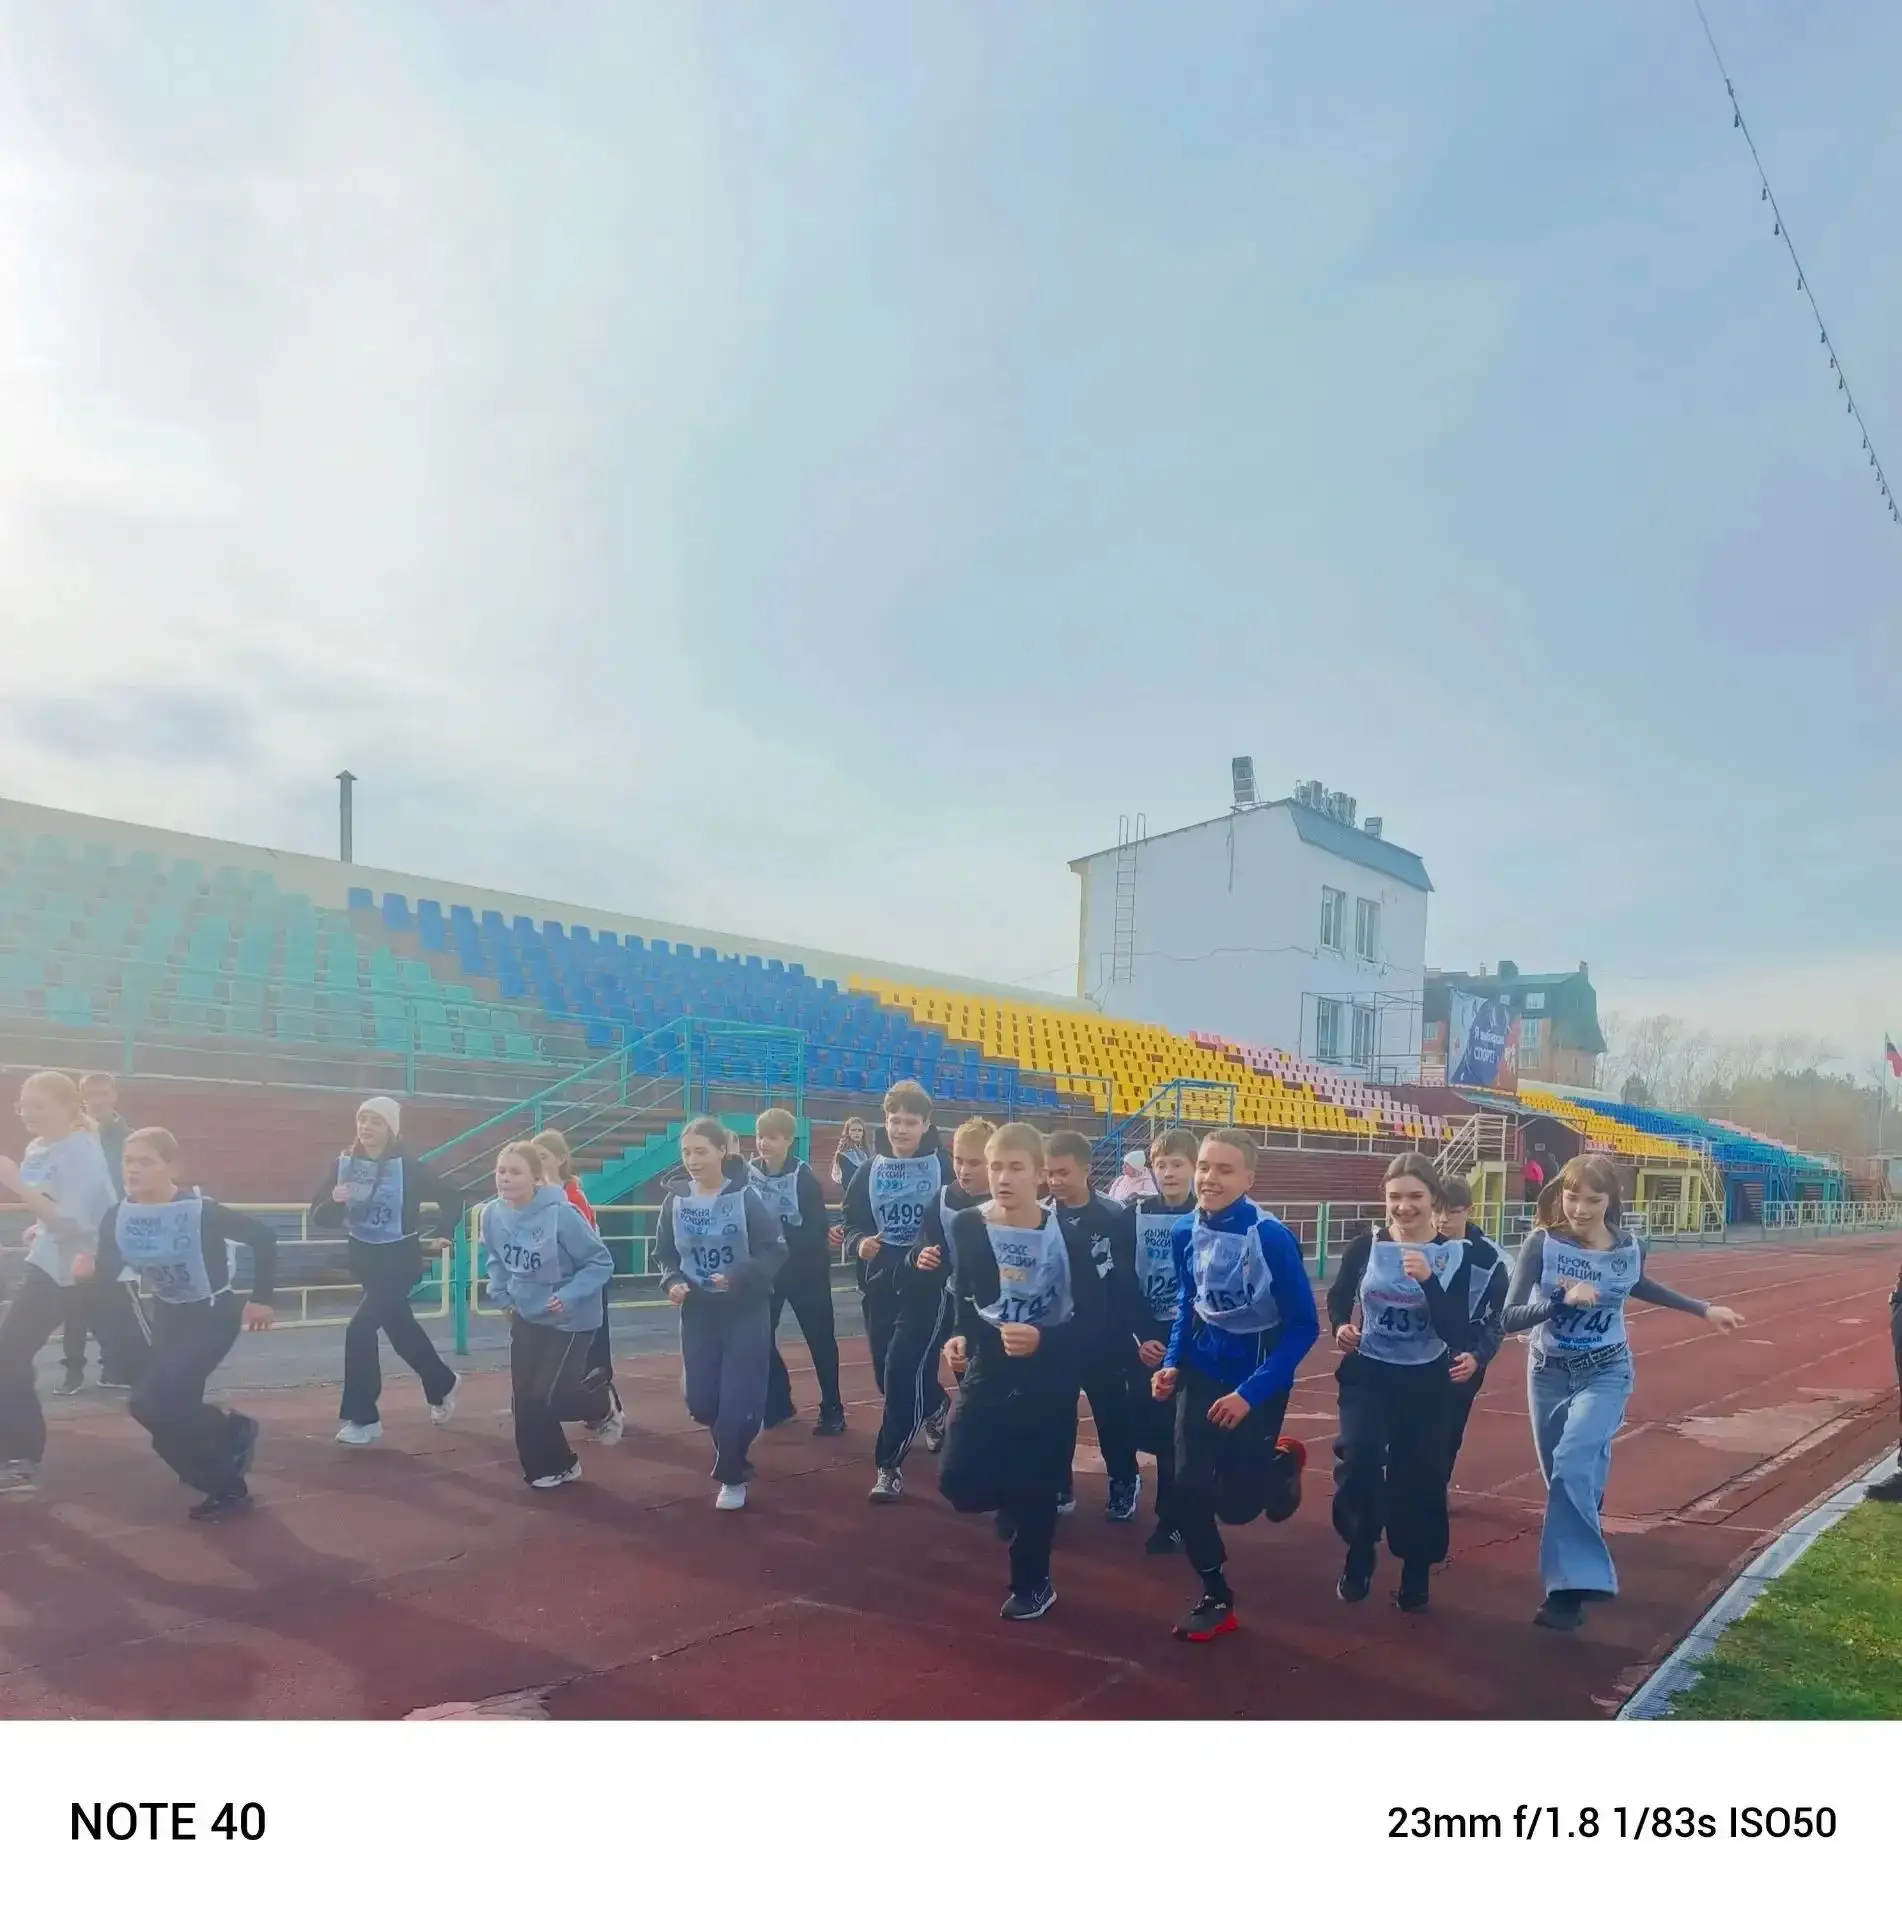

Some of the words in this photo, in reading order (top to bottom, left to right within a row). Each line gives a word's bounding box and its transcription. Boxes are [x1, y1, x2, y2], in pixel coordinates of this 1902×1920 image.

[879, 1203, 924, 1225] 1499
[1144, 1229, 1172, 1238] ЛЫЖН
[503, 1243, 544, 1273] 2736
[1557, 1264, 1602, 1281] НАЦИИ
